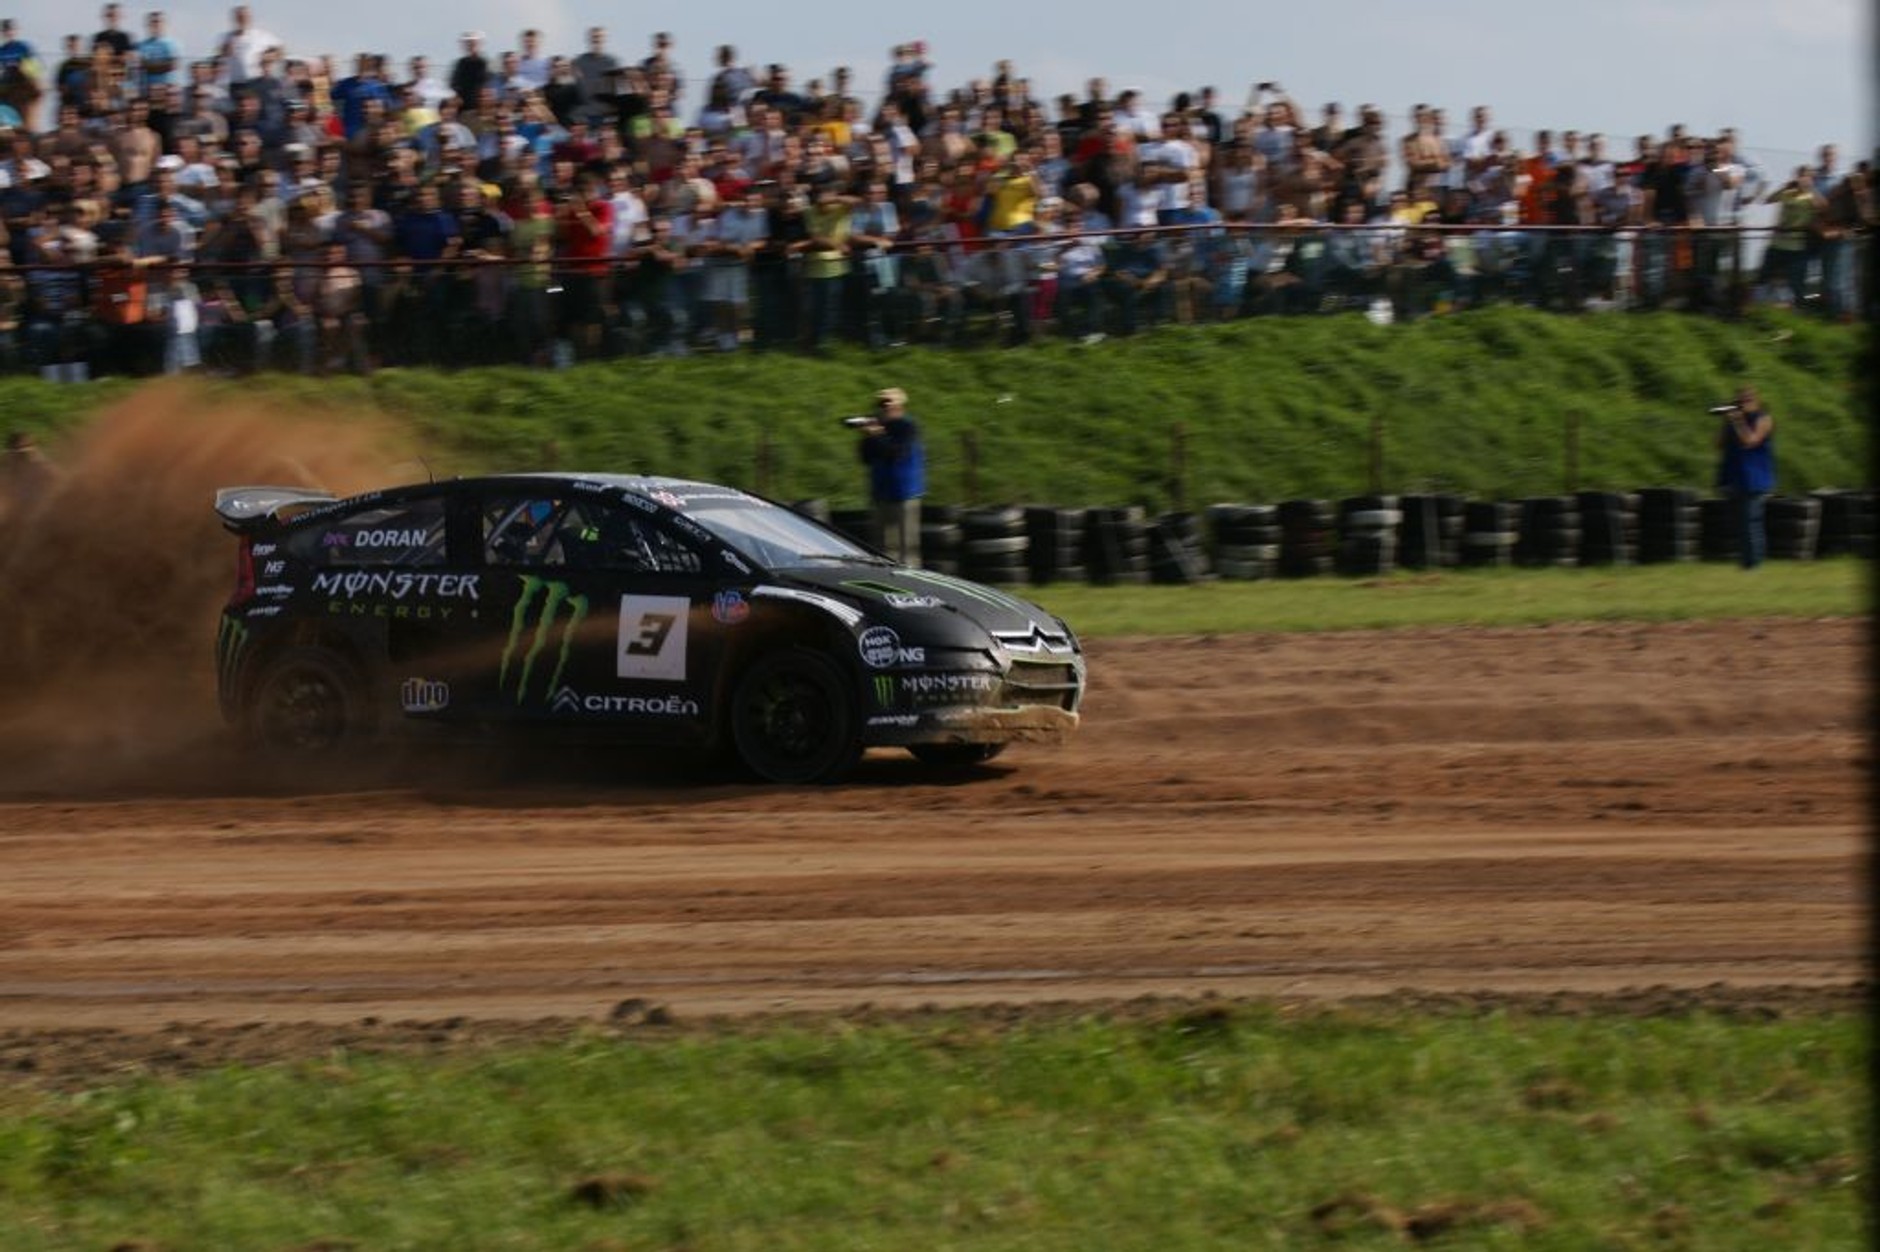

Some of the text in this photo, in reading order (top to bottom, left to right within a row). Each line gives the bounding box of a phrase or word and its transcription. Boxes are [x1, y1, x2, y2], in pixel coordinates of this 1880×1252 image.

[354, 529, 428, 548] DORAN
[311, 569, 481, 600] MONSTER
[328, 602, 454, 619] ENERGY
[625, 612, 677, 657] 3
[900, 647, 925, 662] NG
